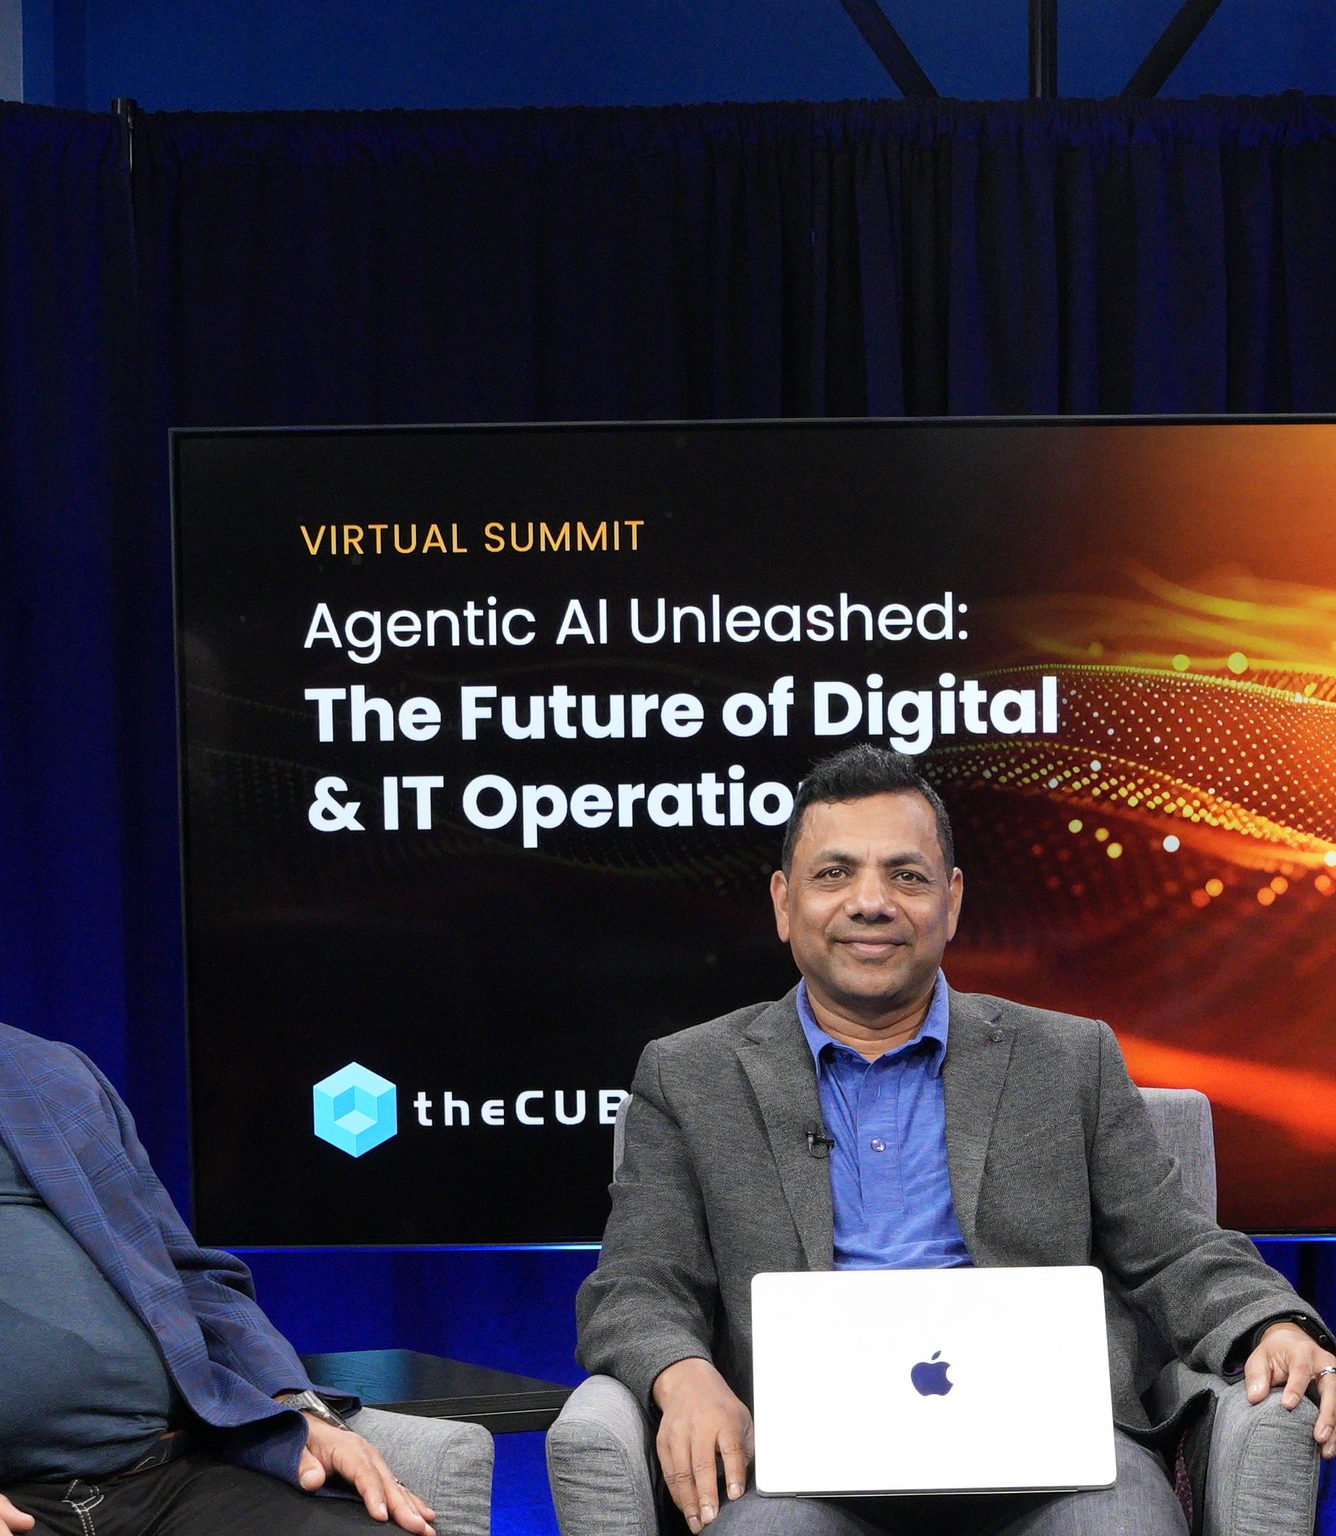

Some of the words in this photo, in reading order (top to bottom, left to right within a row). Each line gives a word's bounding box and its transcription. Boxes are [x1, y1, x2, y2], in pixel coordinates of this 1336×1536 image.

[300, 523, 468, 556] VIRTUAL
[484, 520, 645, 553] SUMMIT
[303, 595, 536, 665] Agentic
[555, 598, 608, 645] AI
[630, 591, 969, 644] Unleashed:
[304, 684, 442, 743] The
[460, 685, 705, 741] Future
[722, 675, 795, 738] of
[813, 672, 1060, 758] Digital
[307, 775, 366, 833] &
[383, 775, 445, 831] IT
[462, 764, 804, 848] Operatio
[413, 1089, 631, 1127] theCUB
